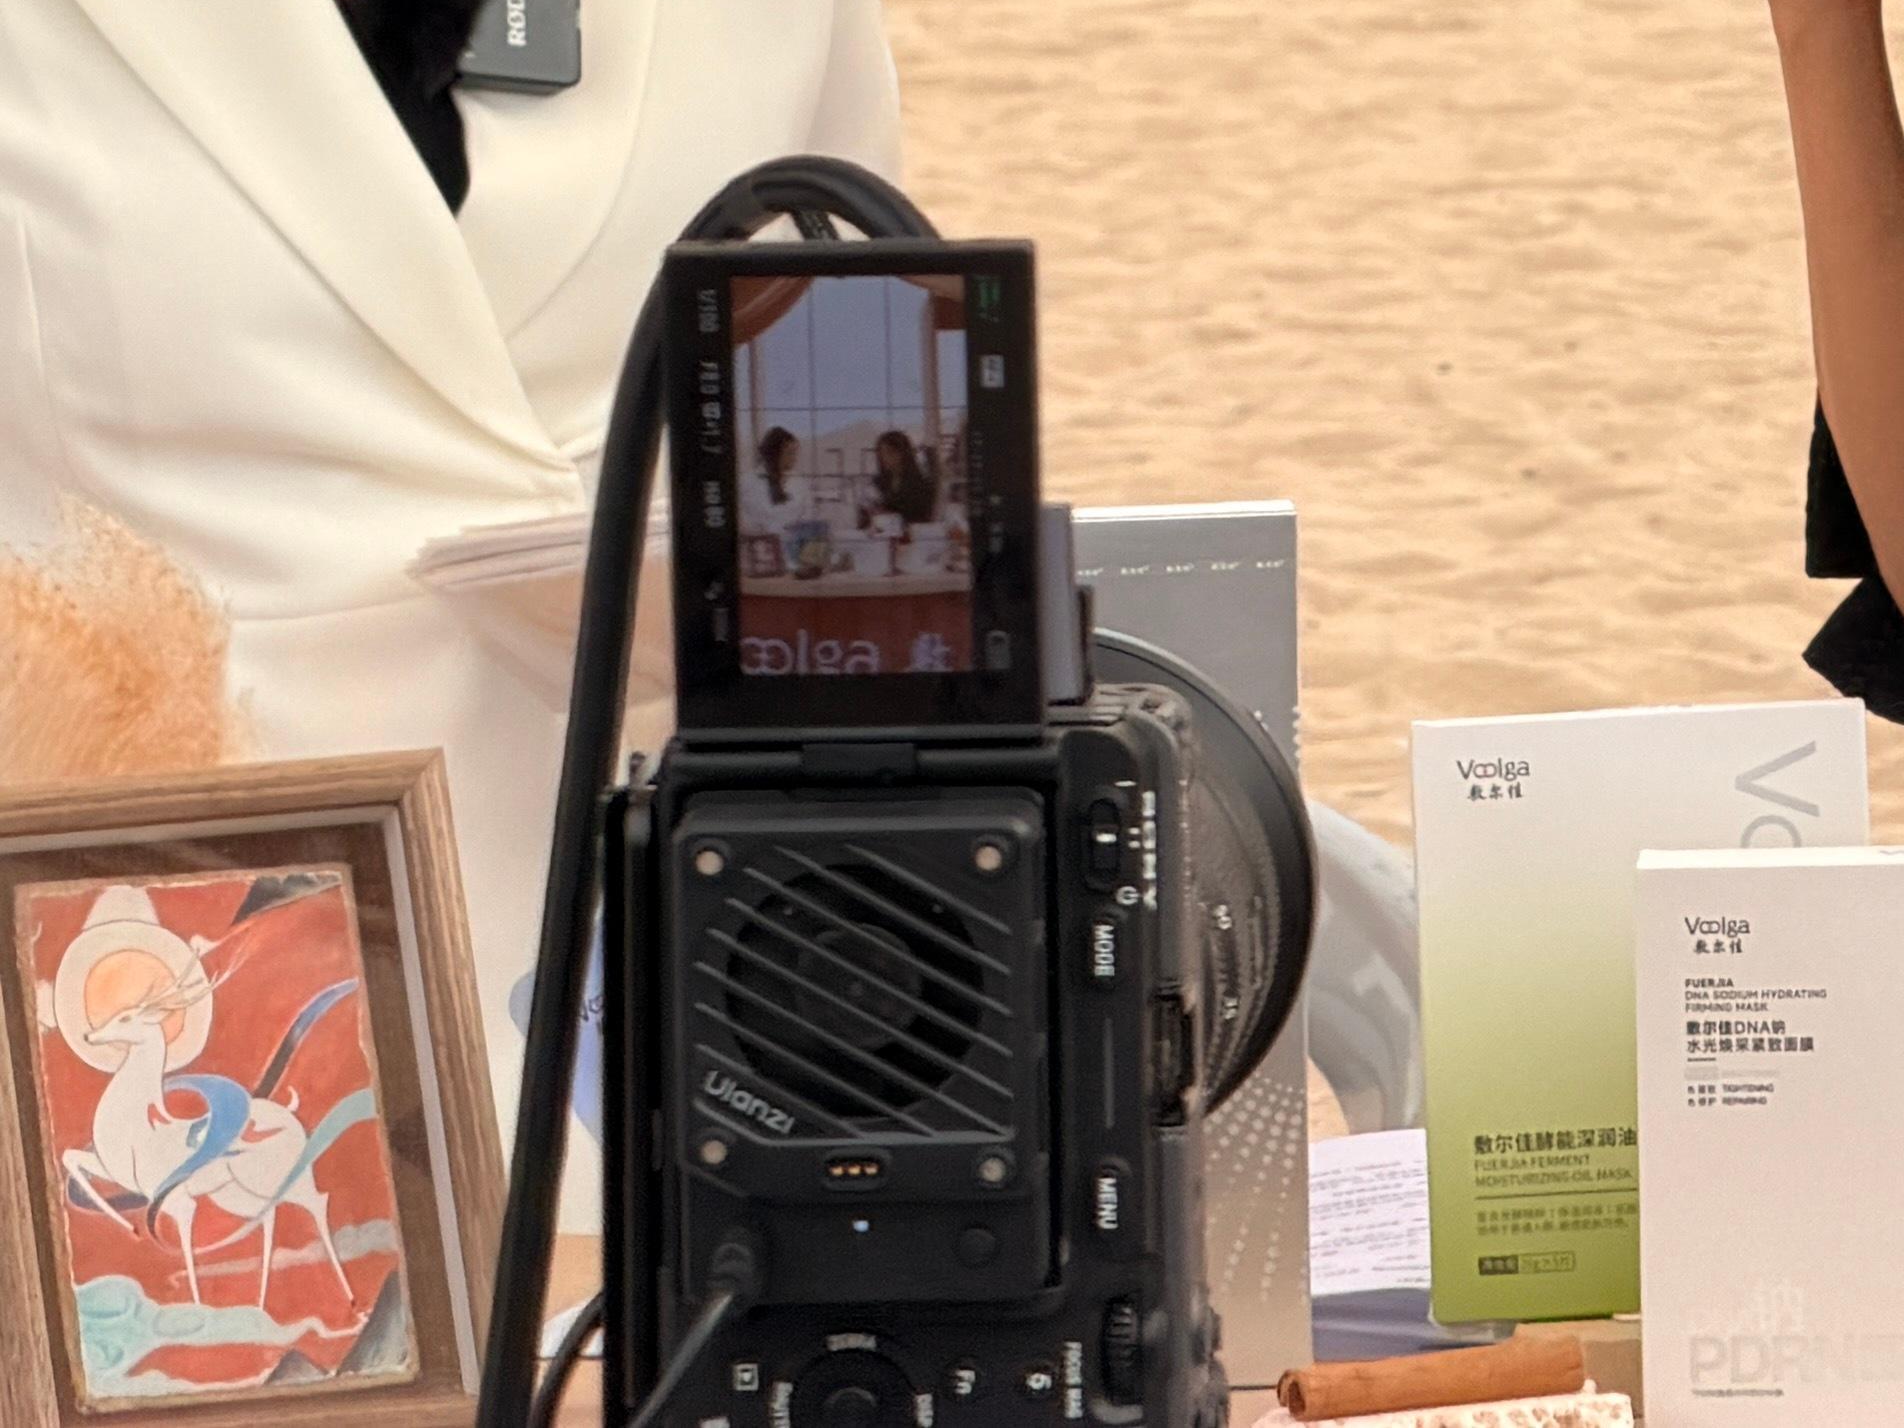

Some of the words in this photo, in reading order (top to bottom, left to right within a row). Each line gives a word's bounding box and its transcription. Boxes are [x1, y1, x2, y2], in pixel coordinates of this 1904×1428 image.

[1456, 756, 1531, 782] Voolga
[1684, 916, 1751, 938] Voolga
[1094, 923, 1115, 978] MODE
[1760, 989, 1828, 1000] HYDRATING
[704, 1070, 796, 1134] Ulanzi
[1097, 1177, 1118, 1230] MENU
